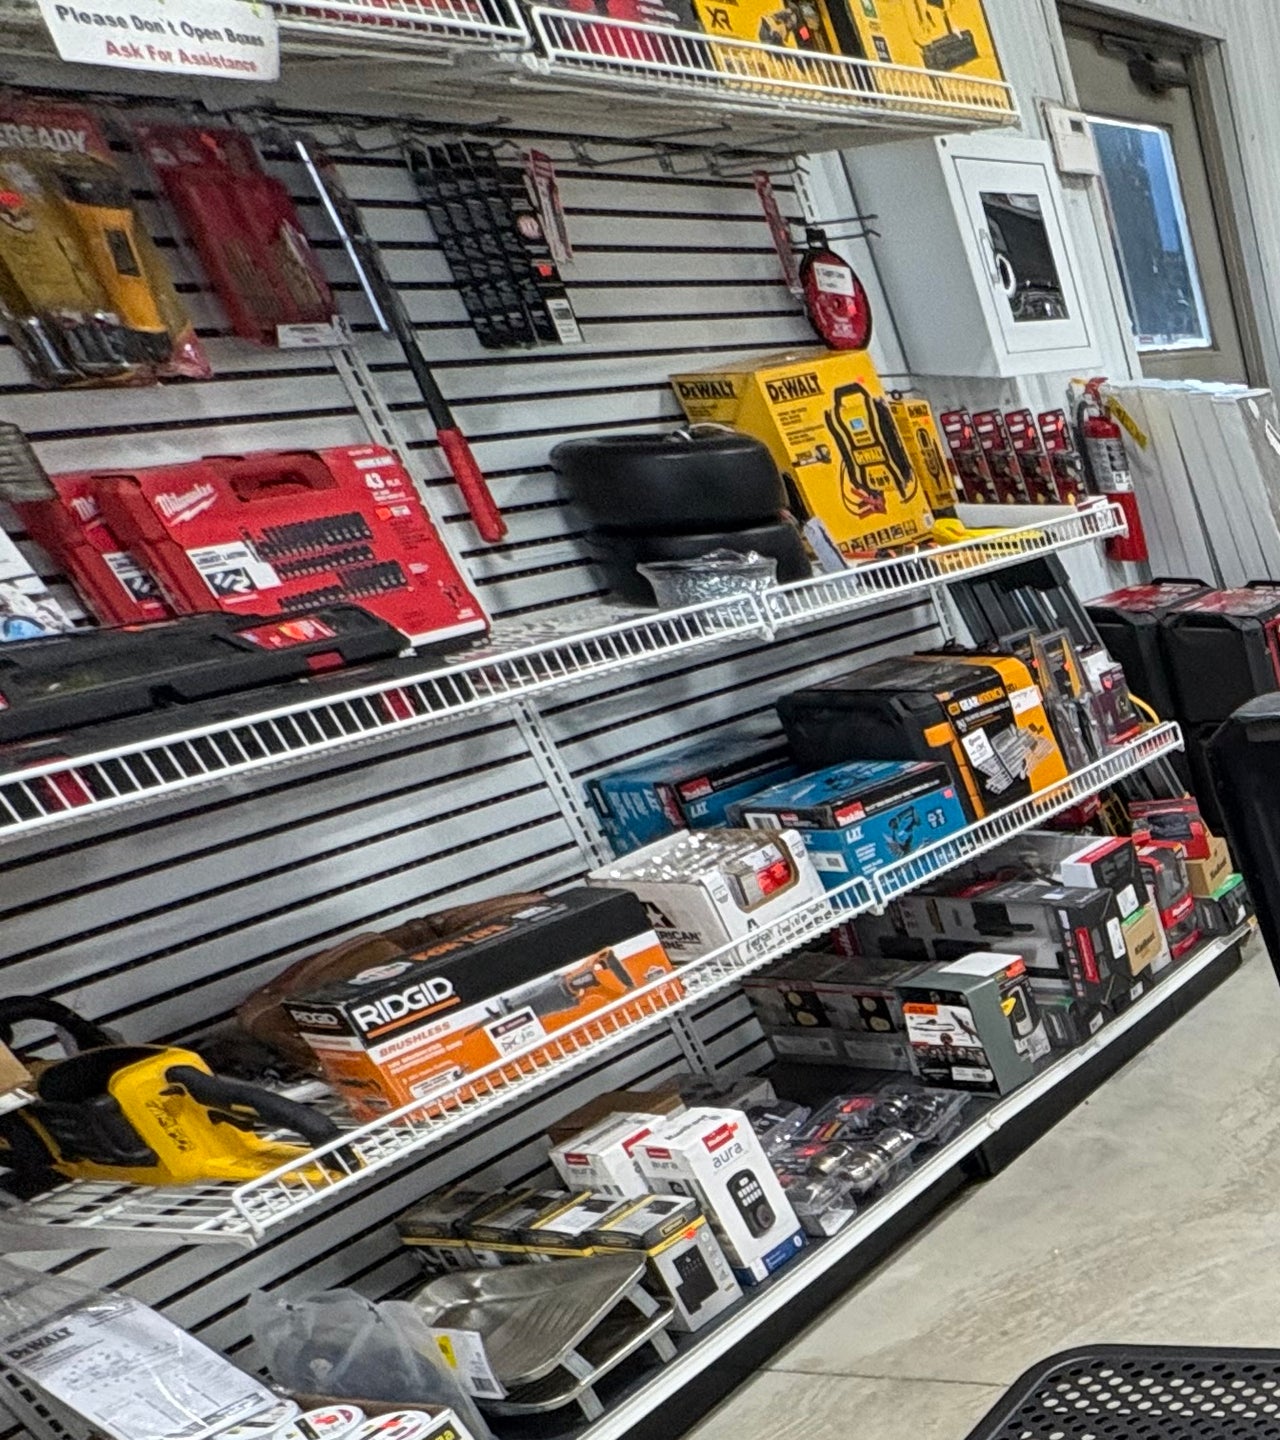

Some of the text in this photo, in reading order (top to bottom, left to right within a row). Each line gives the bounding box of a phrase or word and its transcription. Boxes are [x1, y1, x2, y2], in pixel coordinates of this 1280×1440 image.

[55, 4, 265, 47] Please Don't Open Boxes
[705, 6, 732, 31] XR
[105, 40, 258, 73] Ask For Assistance
[678, 380, 737, 399] DEWALT
[766, 373, 823, 403] DEWALT
[656, 929, 700, 942] RICAN
[290, 1009, 338, 1025] RIDGID
[351, 976, 455, 1032] RIDGID
[379, 1021, 451, 1057] BRUSHLESS
[712, 1140, 744, 1169] aura
[9, 1327, 75, 1360] DEWALT
